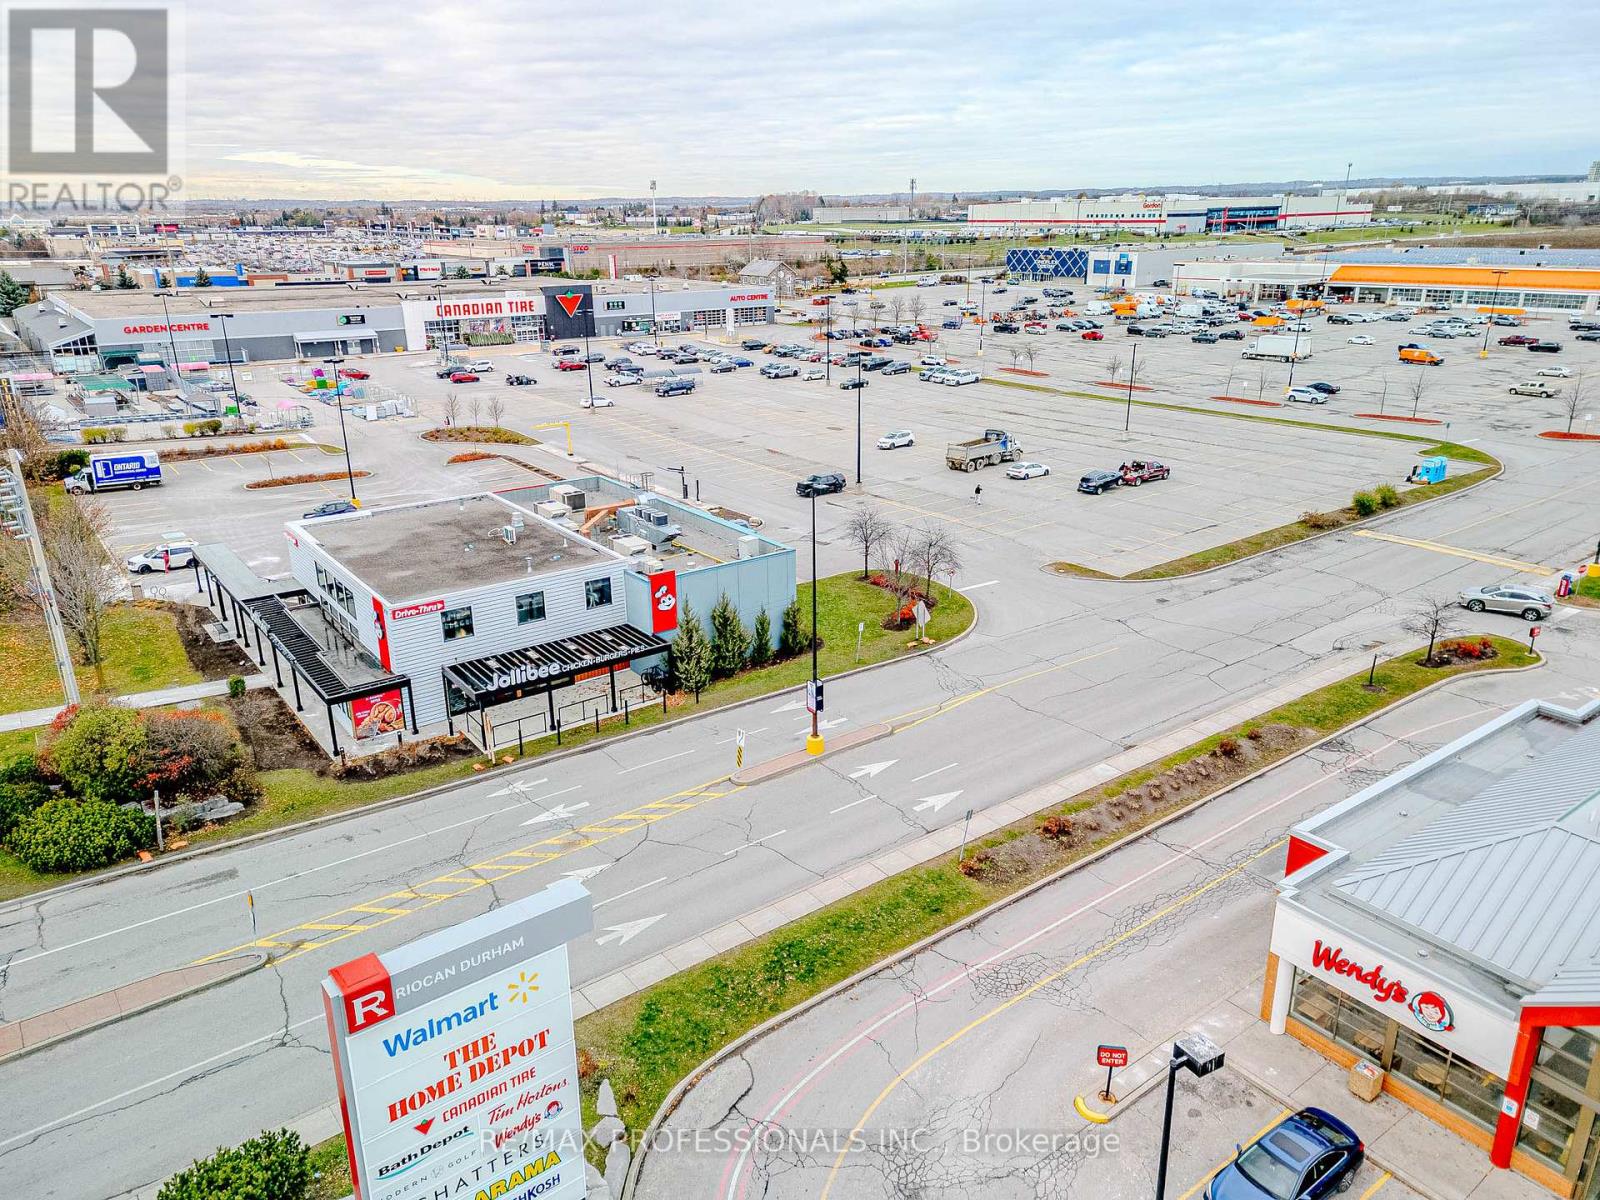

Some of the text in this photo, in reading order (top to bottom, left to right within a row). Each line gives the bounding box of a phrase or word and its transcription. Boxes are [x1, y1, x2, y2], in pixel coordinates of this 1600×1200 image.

[436, 300, 535, 317] CANADIAN TIRE
[746, 293, 768, 301] CENTRE
[123, 323, 209, 334] GARDEN CENTRE
[114, 462, 140, 470] ONTARIO
[394, 605, 438, 618] Drive-Thru
[486, 662, 562, 691] Jollibee
[395, 936, 525, 1000] RIOCAN DURHAM
[1312, 939, 1409, 1003] Wendy's
[382, 991, 499, 1058] Walmart
[443, 1032, 497, 1071] THE
[387, 1028, 551, 1123] HOME DEPOT
[442, 1066, 537, 1123] CANADIAN TIRE
[488, 1078, 567, 1125] Tim Hortons
[495, 1112, 541, 1149] Wendy's
[380, 1149, 477, 1200] ODERN GOLF
[513, 1173, 560, 1200] HKOSH
